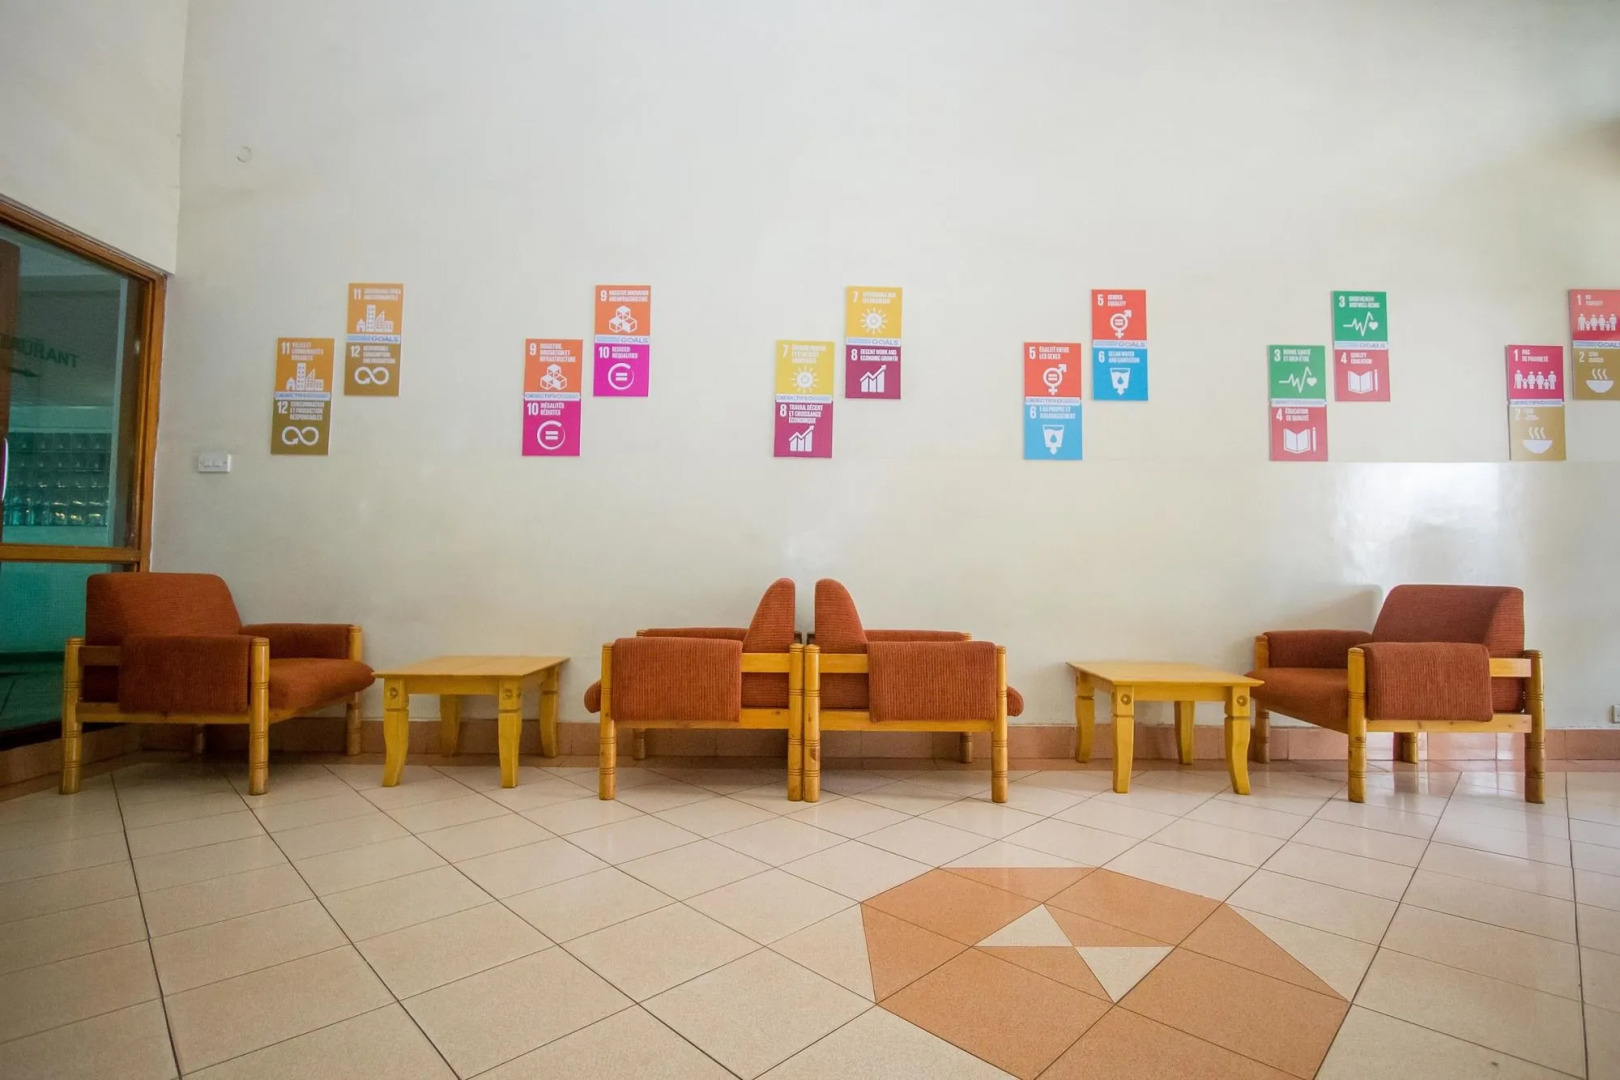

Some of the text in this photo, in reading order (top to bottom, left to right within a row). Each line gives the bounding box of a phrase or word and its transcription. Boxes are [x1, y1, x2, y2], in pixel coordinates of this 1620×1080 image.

[353, 288, 361, 300] 11
[600, 290, 607, 302] 9
[854, 291, 858, 303] 7
[1097, 294, 1104, 306] 5
[1339, 296, 1345, 308] 3
[1577, 295, 1581, 306] 1
[282, 343, 290, 354] 11
[351, 346, 360, 357] 12
[530, 343, 536, 355] 9
[599, 346, 609, 359] 10
[782, 345, 788, 357] 7
[1029, 347, 1036, 359] 5
[851, 349, 857, 361] 8
[1098, 351, 1105, 363] 6
[1274, 349, 1281, 362] 3
[1341, 352, 1347, 364] 4
[1514, 349, 1518, 362] 1
[1579, 352, 1585, 363] 2
[277, 402, 288, 414] 12
[527, 403, 539, 415] 10
[780, 404, 787, 417] 8
[1030, 406, 1036, 419] 6
[1276, 408, 1283, 421] 4
[1515, 408, 1521, 421] 2
